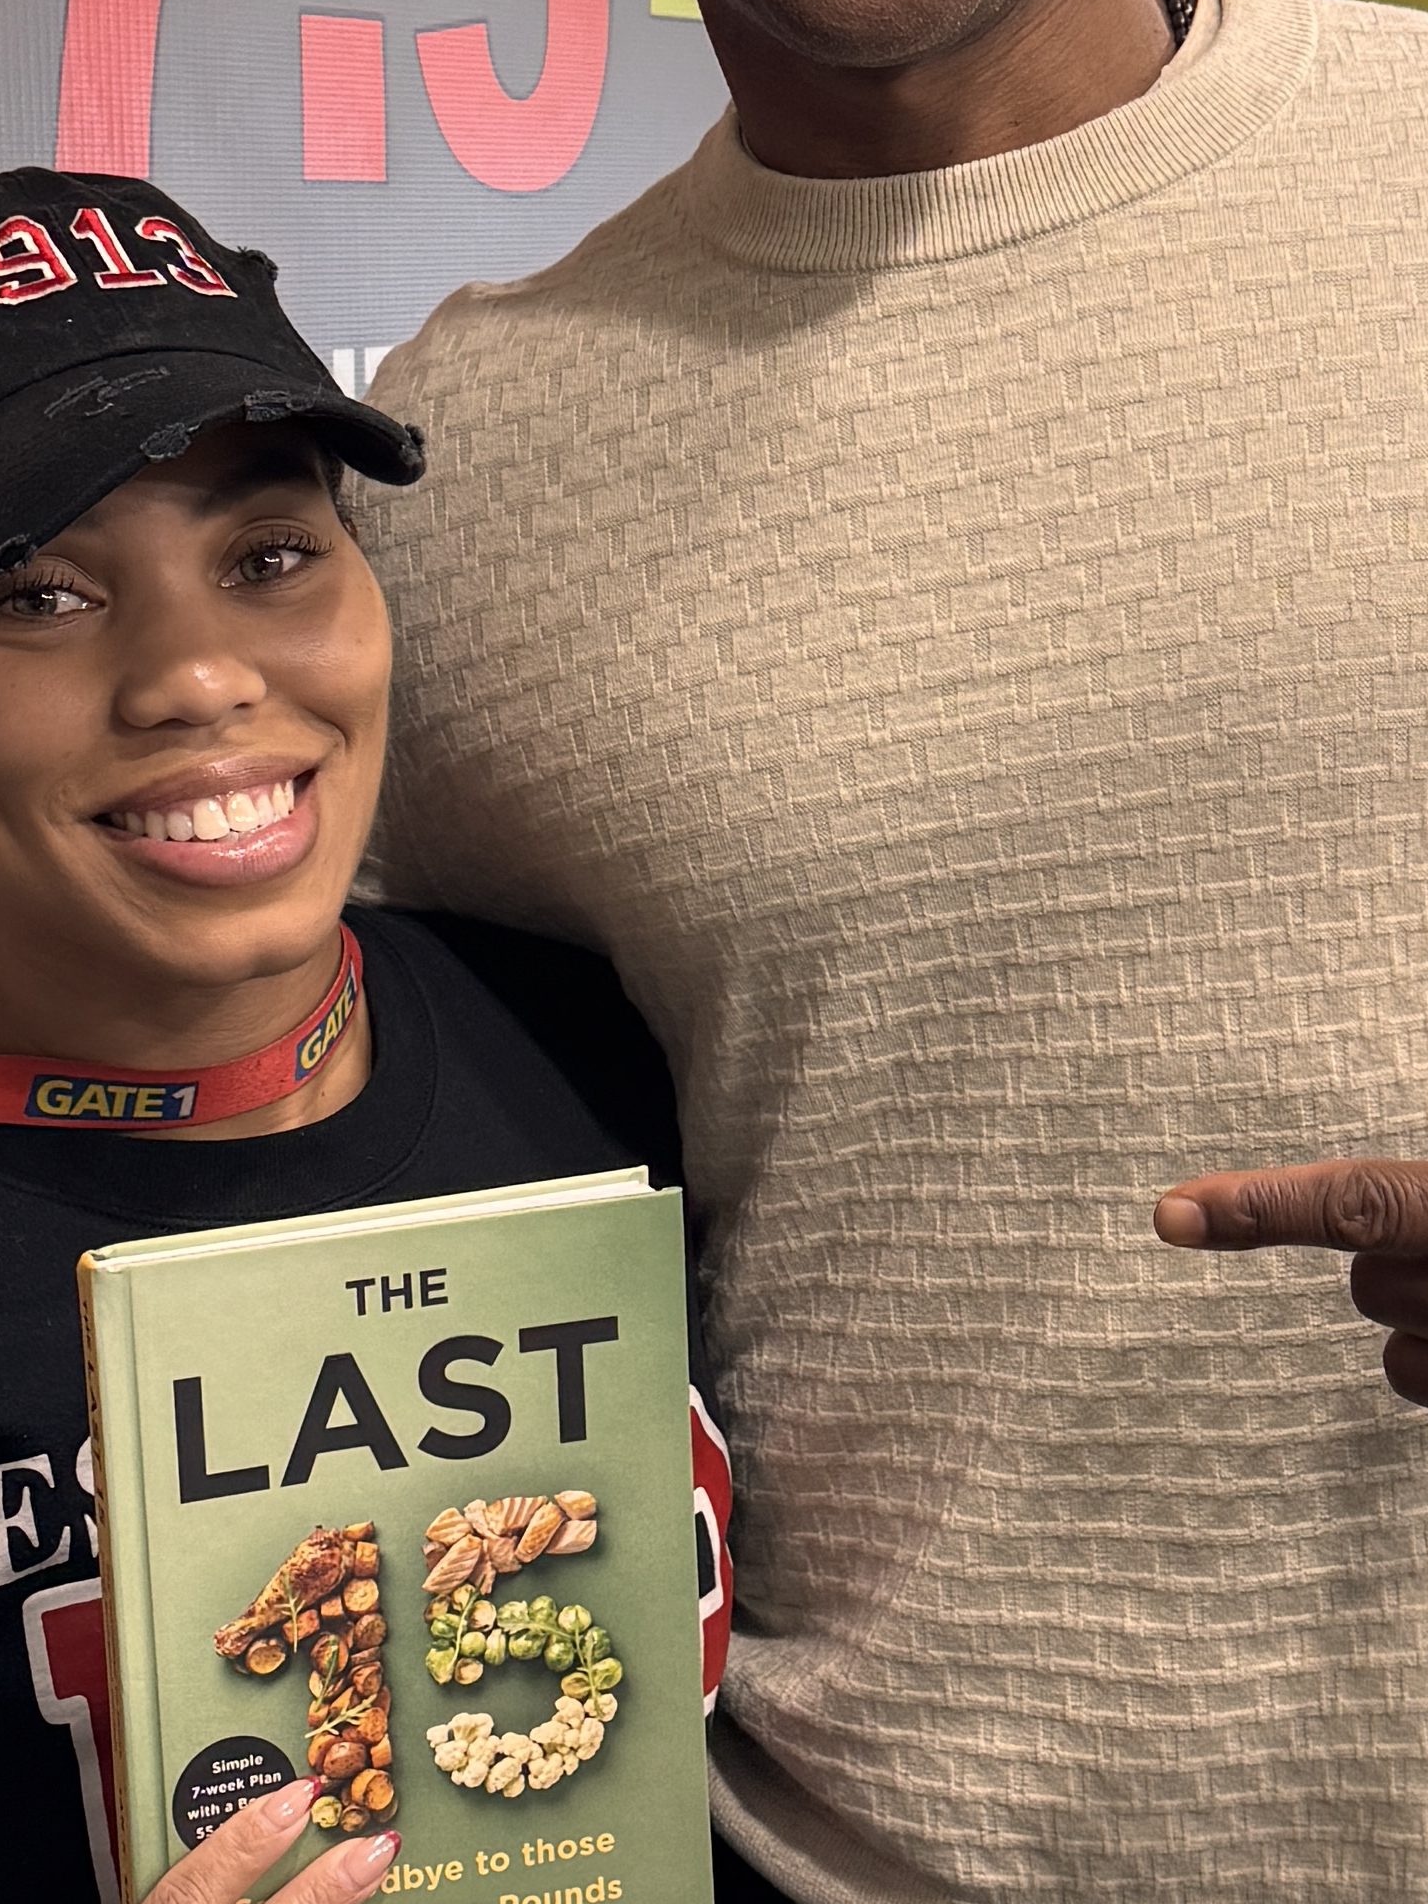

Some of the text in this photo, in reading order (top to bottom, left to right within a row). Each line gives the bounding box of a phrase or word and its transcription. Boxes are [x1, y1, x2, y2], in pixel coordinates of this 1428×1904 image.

[345, 1268, 449, 1317] THE
[172, 1315, 620, 1505] LAST
[213, 1489, 624, 1833] 15
[191, 1771, 283, 1800] 7-week Plan
[212, 1754, 264, 1775] Simple
[187, 1803, 220, 1821] with
[224, 1802, 234, 1813] a
[476, 1849, 511, 1876] to
[522, 1831, 616, 1868] those
